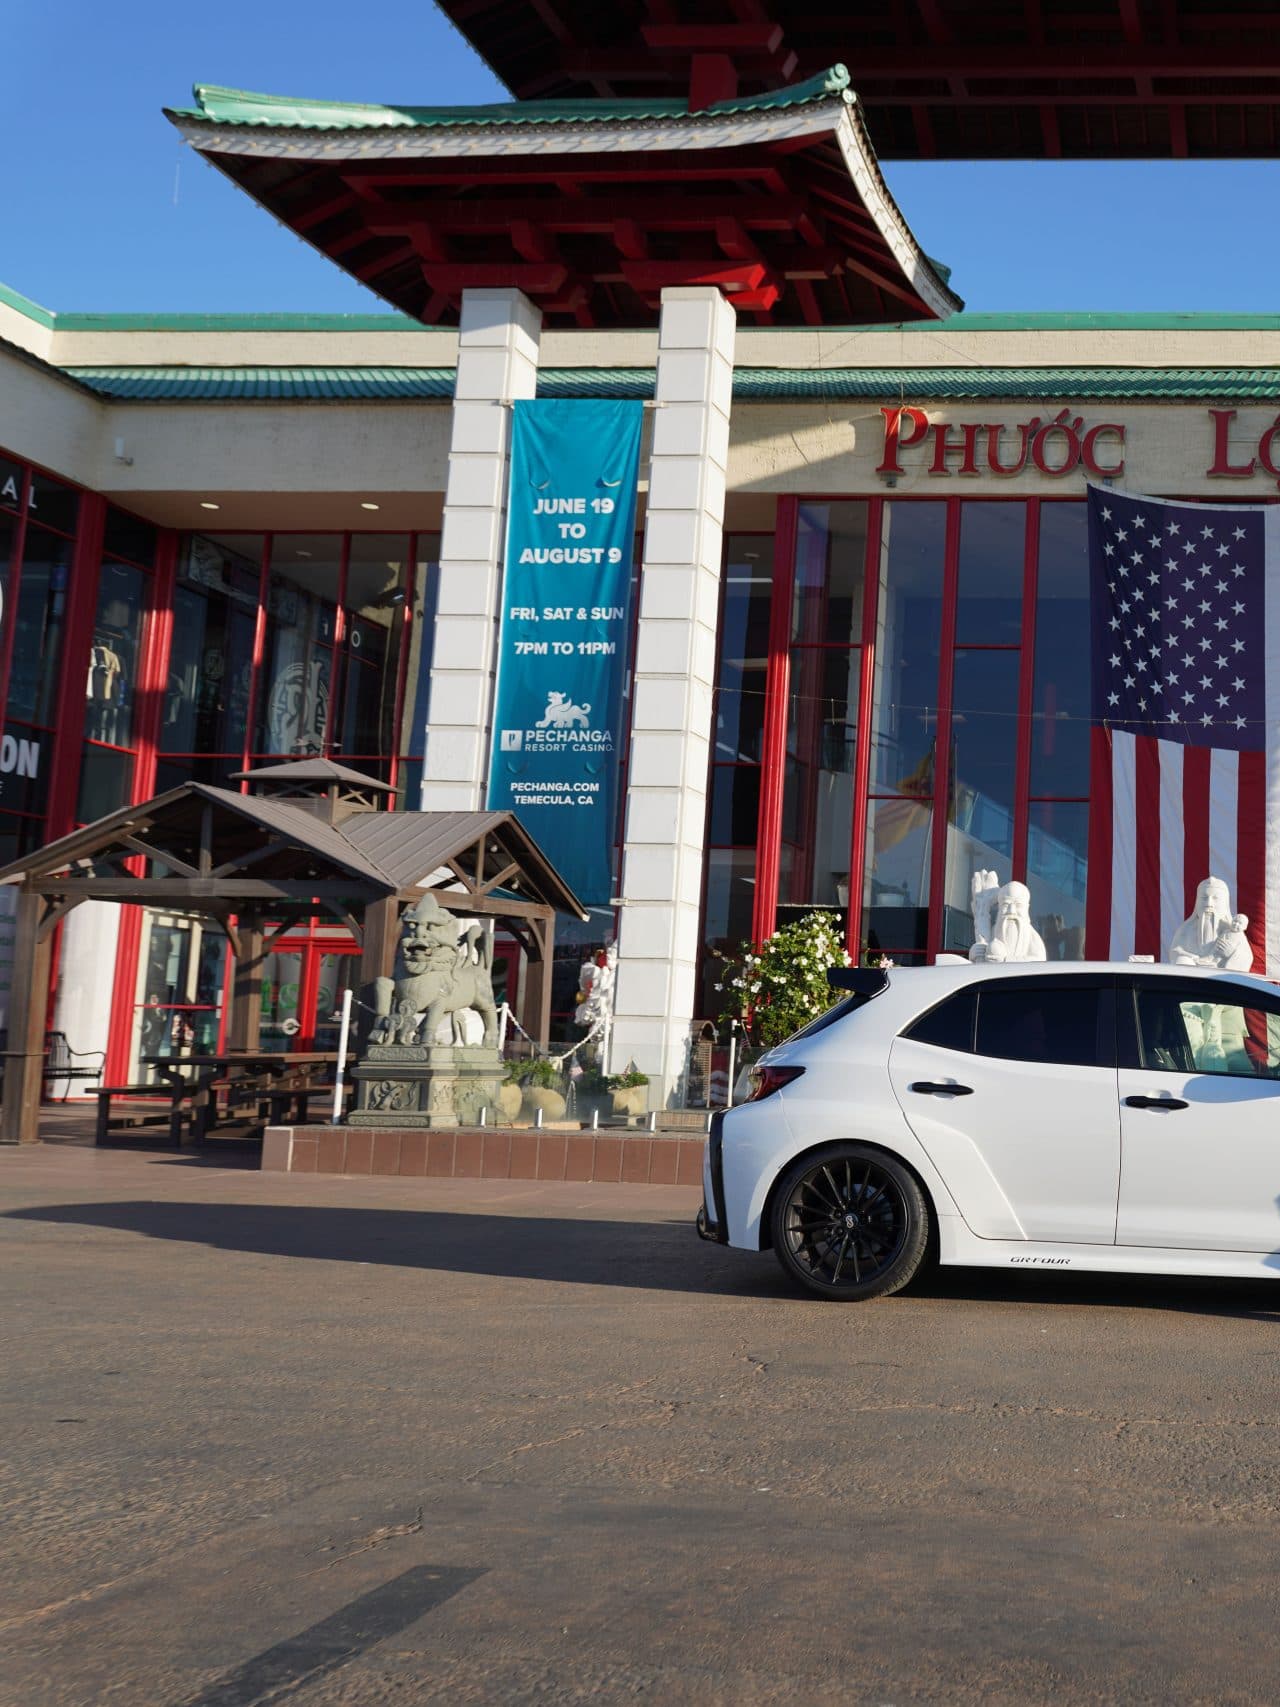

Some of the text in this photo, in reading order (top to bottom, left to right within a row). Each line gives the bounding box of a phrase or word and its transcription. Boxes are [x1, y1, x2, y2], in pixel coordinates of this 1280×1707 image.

[533, 497, 615, 514] JUNE 19
[558, 523, 586, 539] TO
[519, 547, 622, 564] AUGUST 9
[510, 607, 624, 622] FRI, SAT & SUN
[514, 642, 616, 655] 7PM TO 11PM
[525, 730, 612, 742] PECHANGA
[525, 744, 613, 752] RESORT CASINO
[510, 782, 600, 792] PECHANGA.COM
[514, 795, 594, 806] TEMECULA, CA
